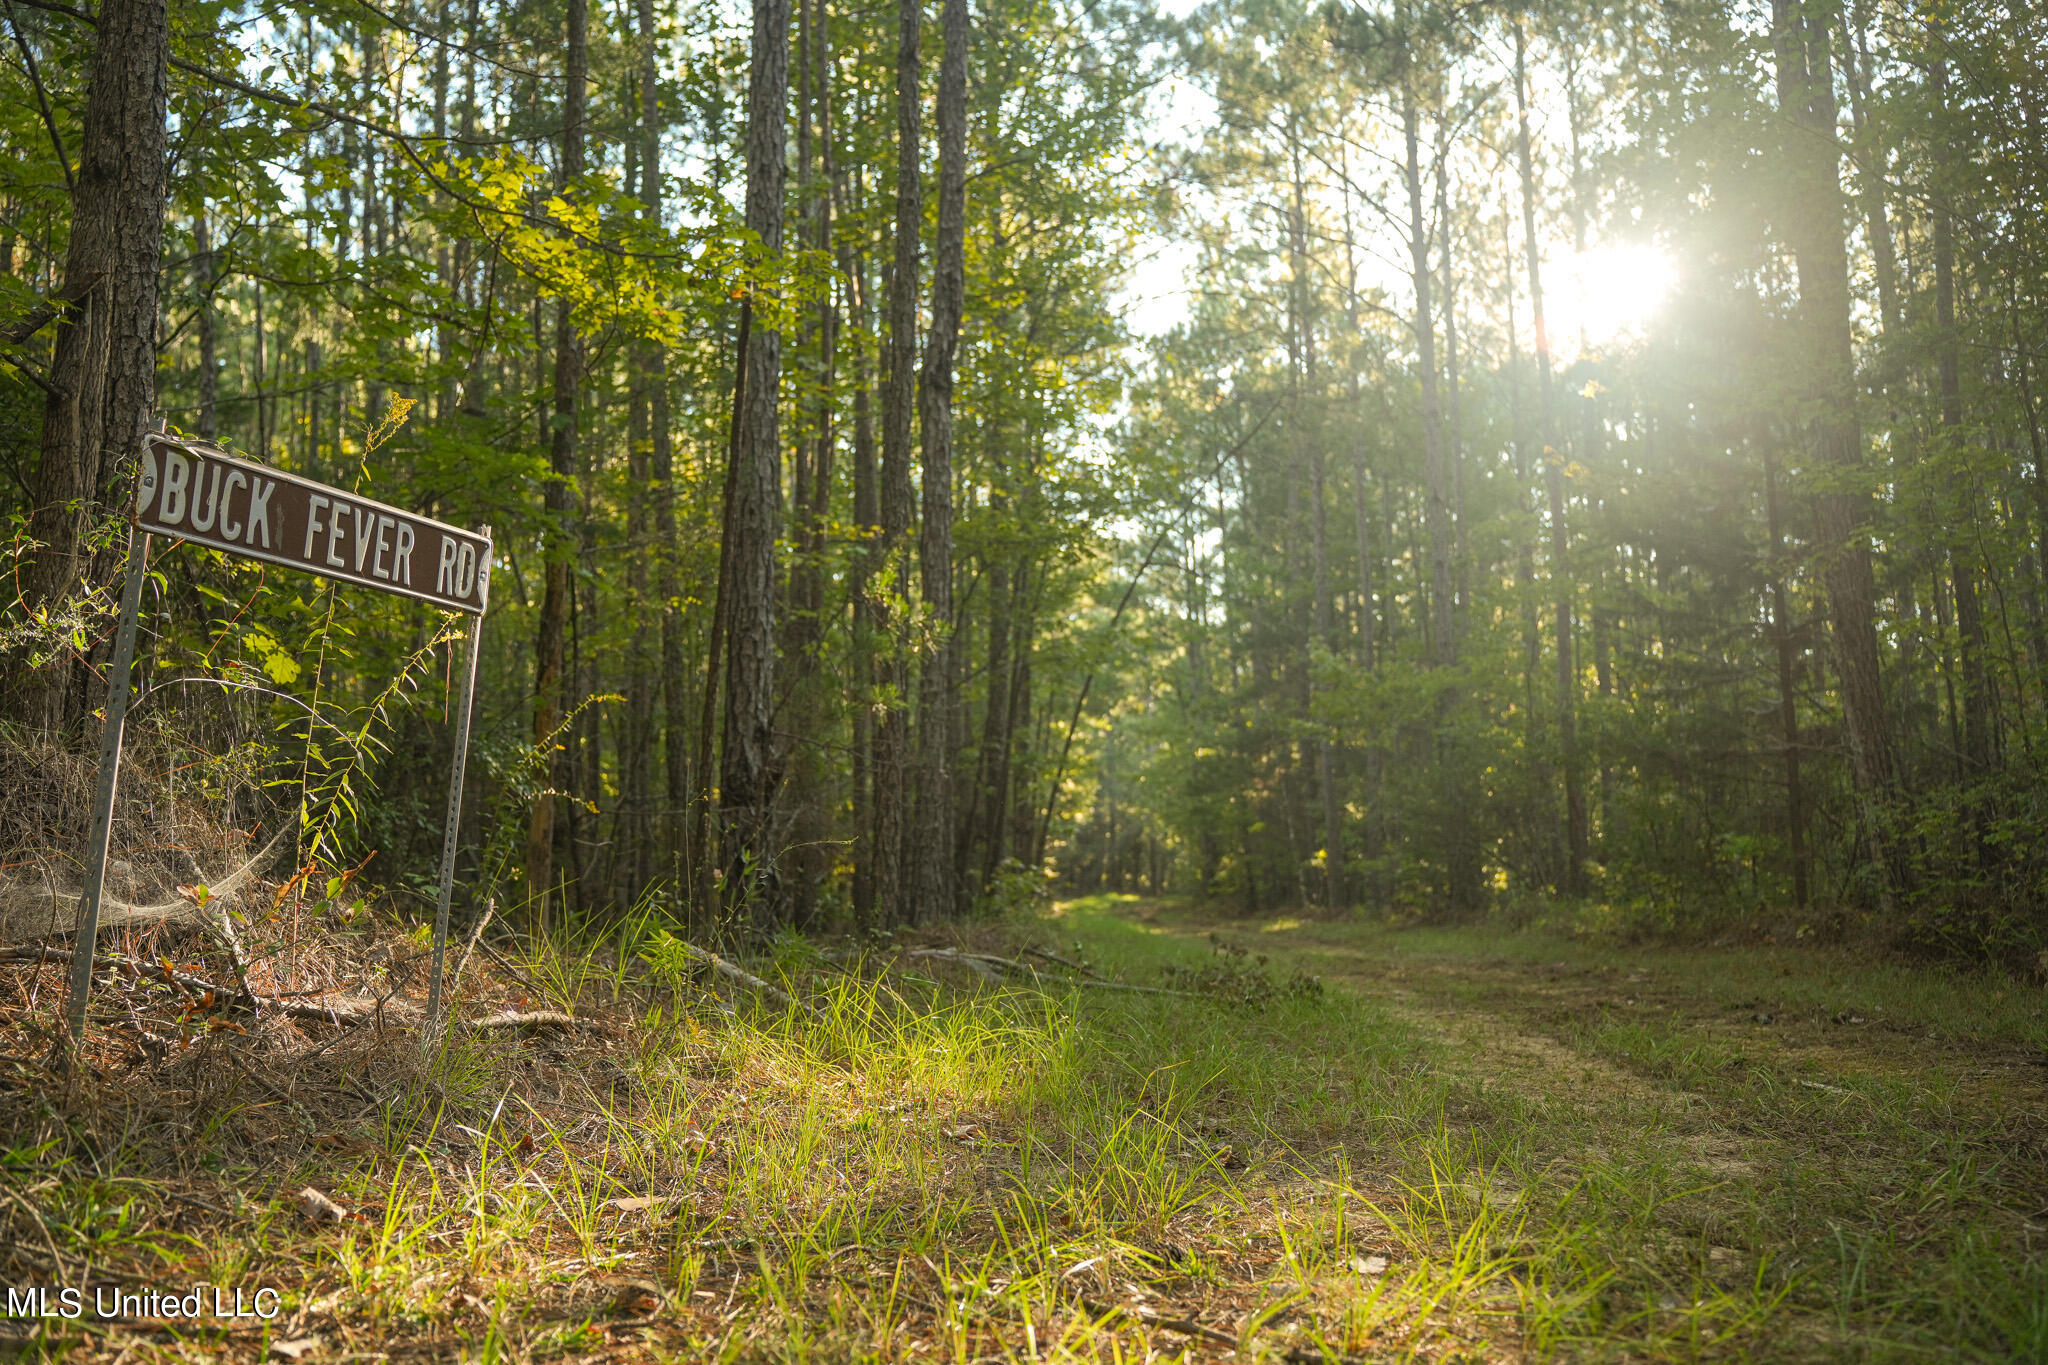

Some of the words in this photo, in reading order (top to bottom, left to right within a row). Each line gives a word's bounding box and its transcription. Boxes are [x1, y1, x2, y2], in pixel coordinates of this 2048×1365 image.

[158, 449, 276, 549] BUCK
[303, 493, 415, 587] FEVER
[436, 535, 476, 599] RD
